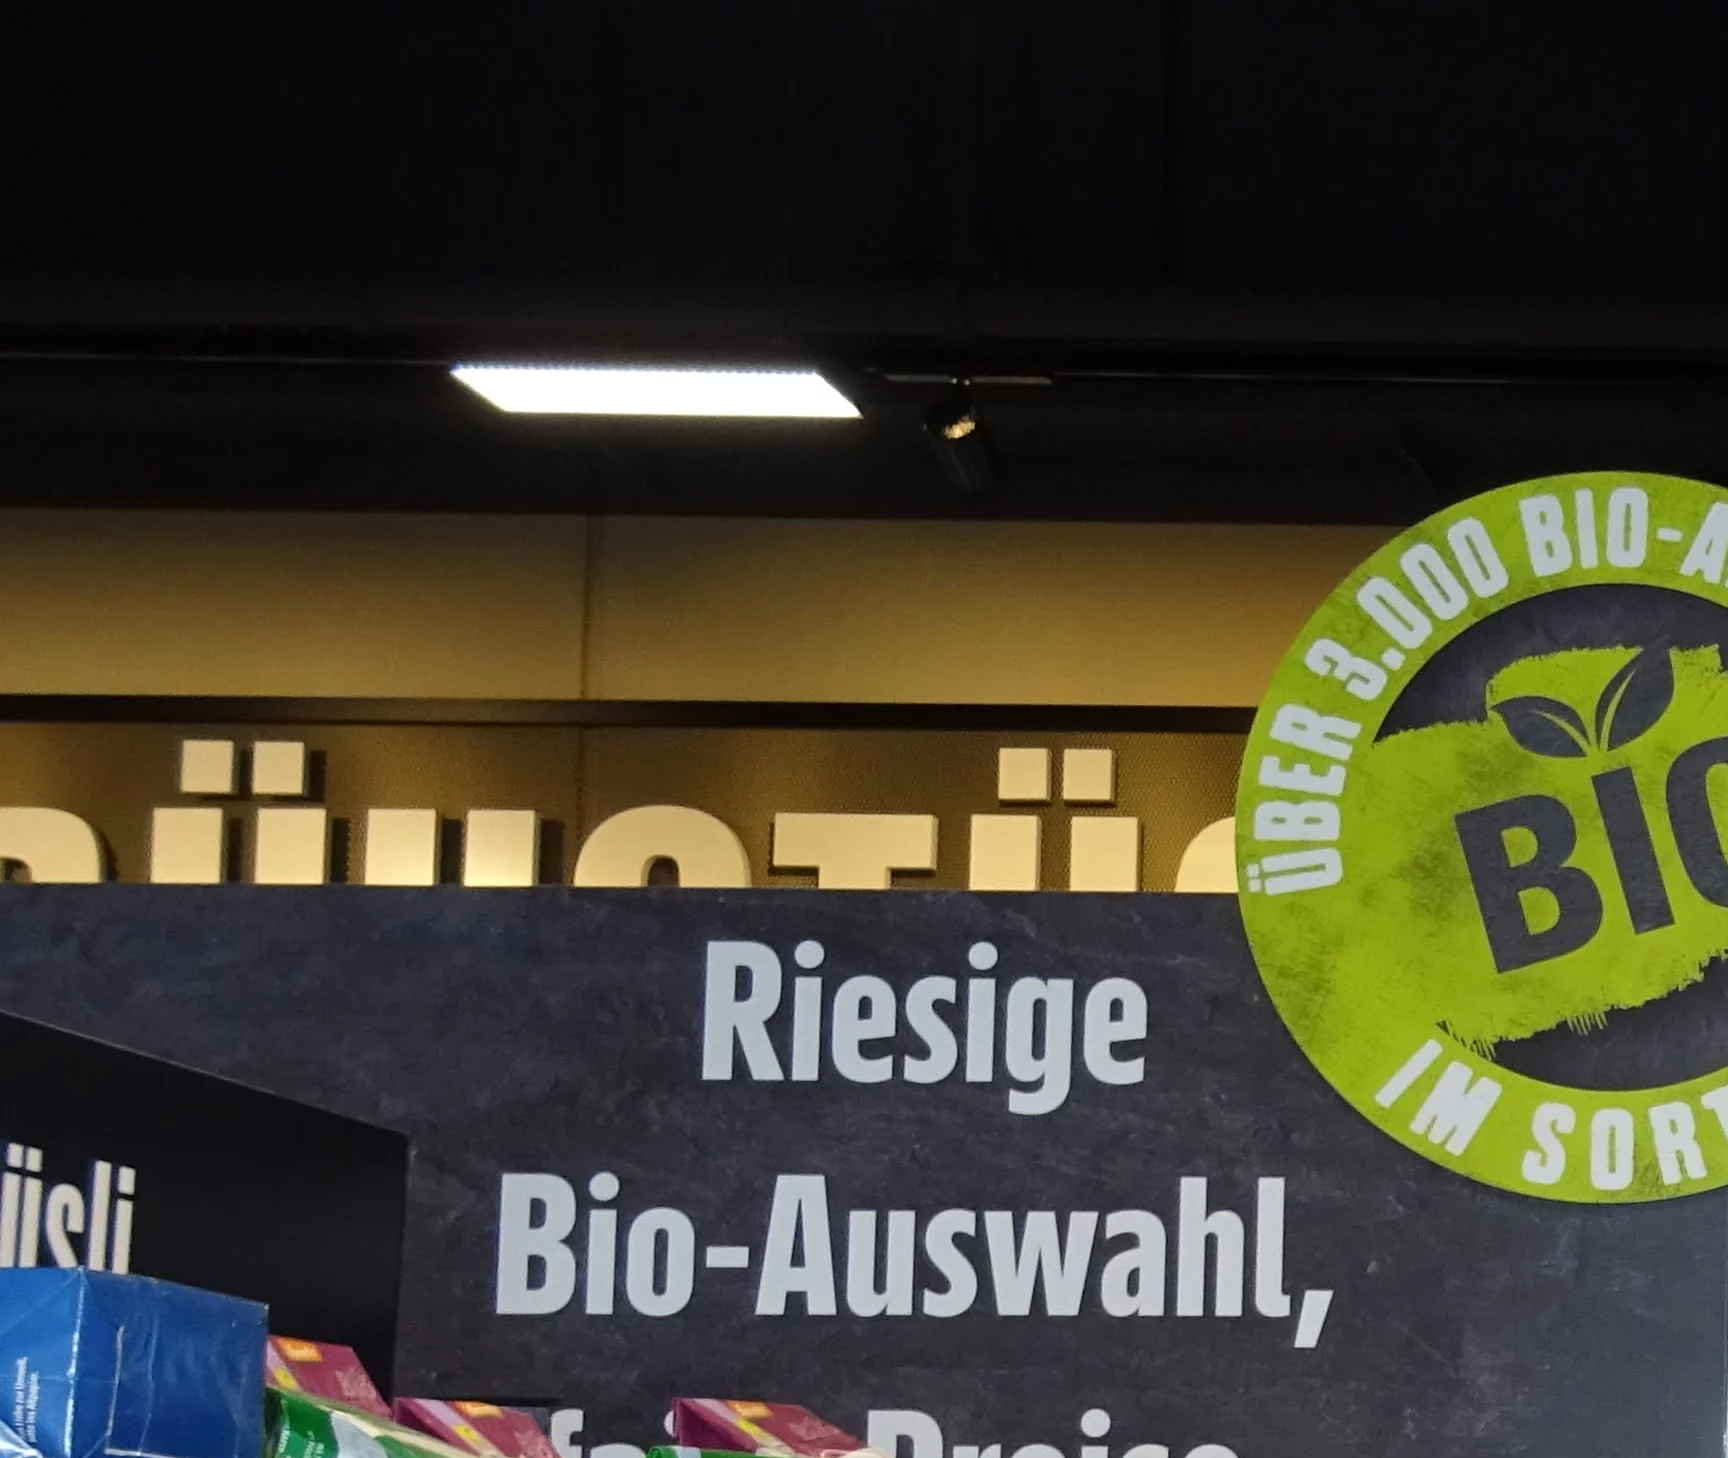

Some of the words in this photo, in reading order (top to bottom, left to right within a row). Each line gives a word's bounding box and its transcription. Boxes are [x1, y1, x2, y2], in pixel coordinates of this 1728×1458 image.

[1246, 702, 1361, 897] ÜBER
[1304, 516, 1512, 701] 3.000
[701, 941, 1148, 1114] Riesige
[1376, 1037, 1502, 1158] IM
[495, 1173, 1333, 1352] Bio-Auswahl,
